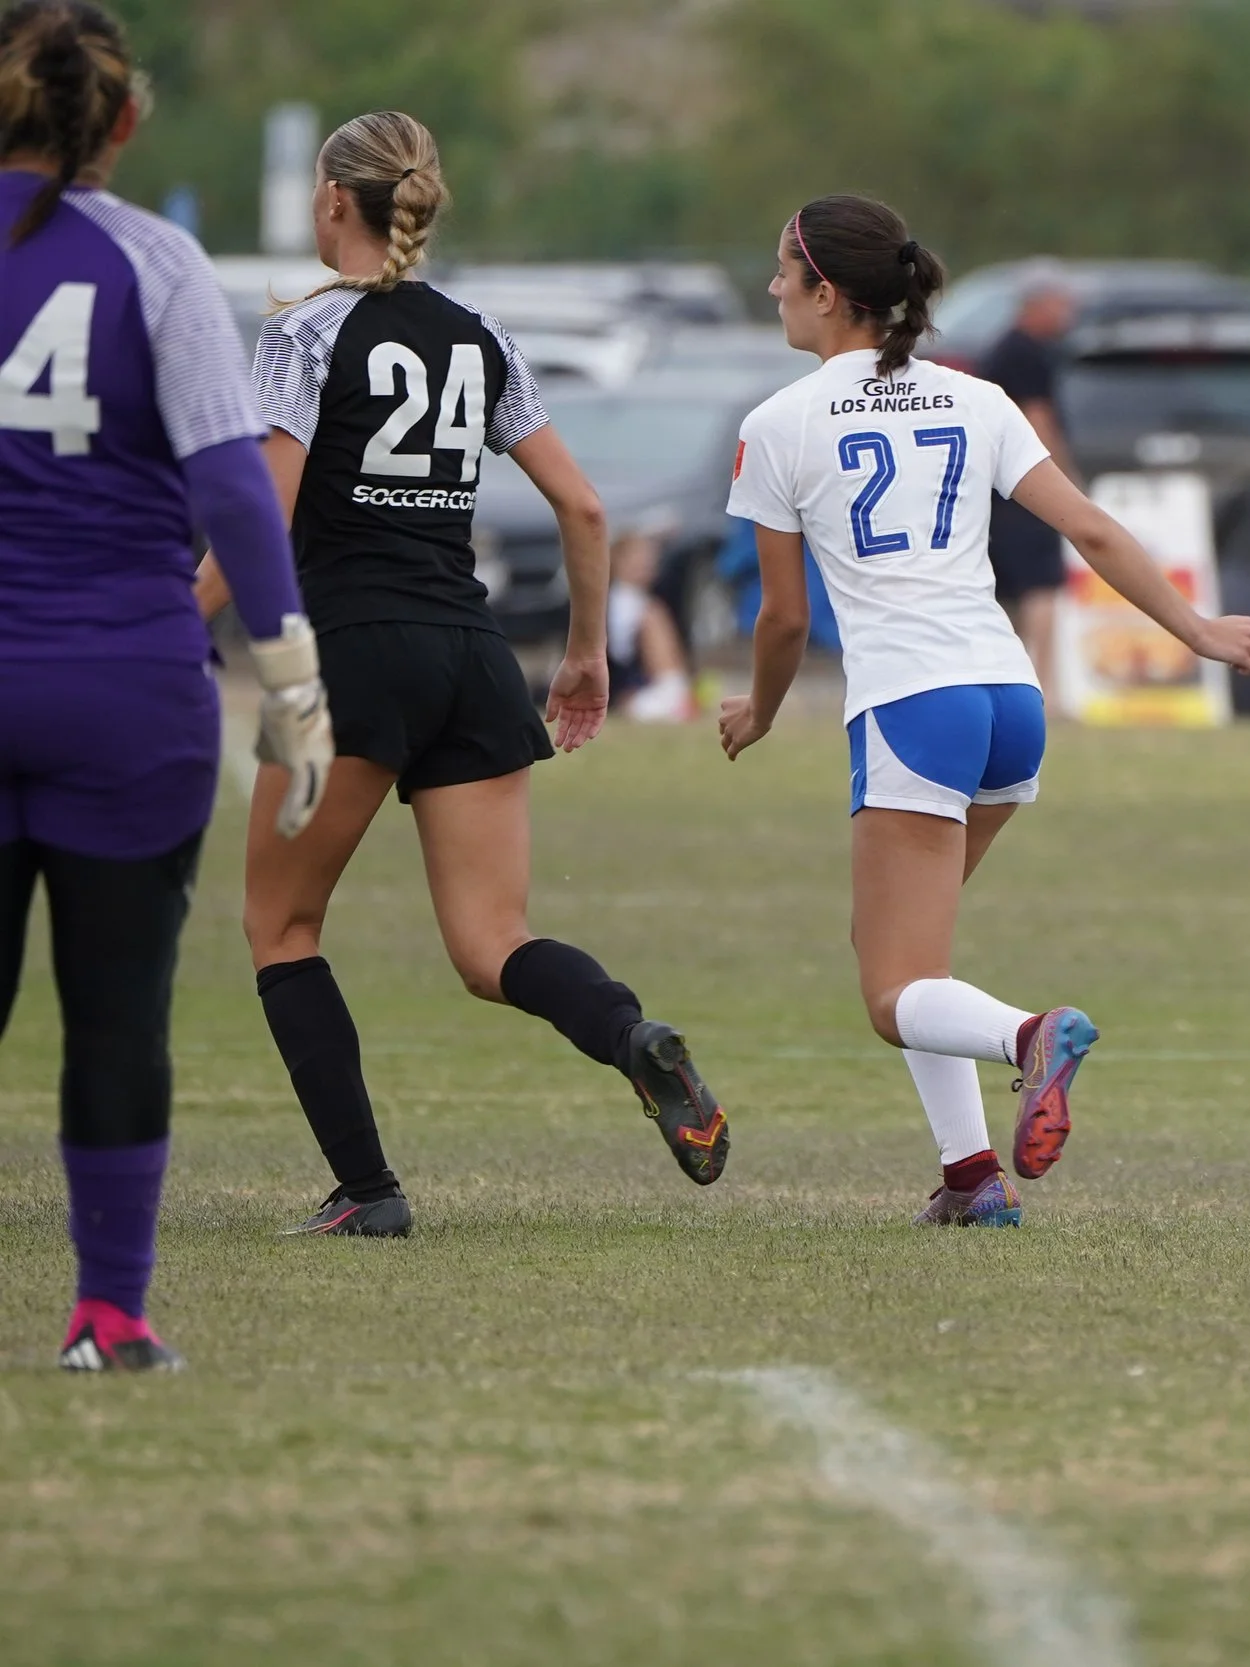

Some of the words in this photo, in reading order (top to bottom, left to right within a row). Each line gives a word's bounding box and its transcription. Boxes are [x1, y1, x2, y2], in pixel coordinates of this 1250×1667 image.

[0, 281, 100, 456] 4
[360, 341, 486, 482] 24
[830, 400, 866, 416] LOS
[870, 395, 954, 413] ANGELES
[863, 380, 917, 397] SURF
[837, 426, 968, 558] 27
